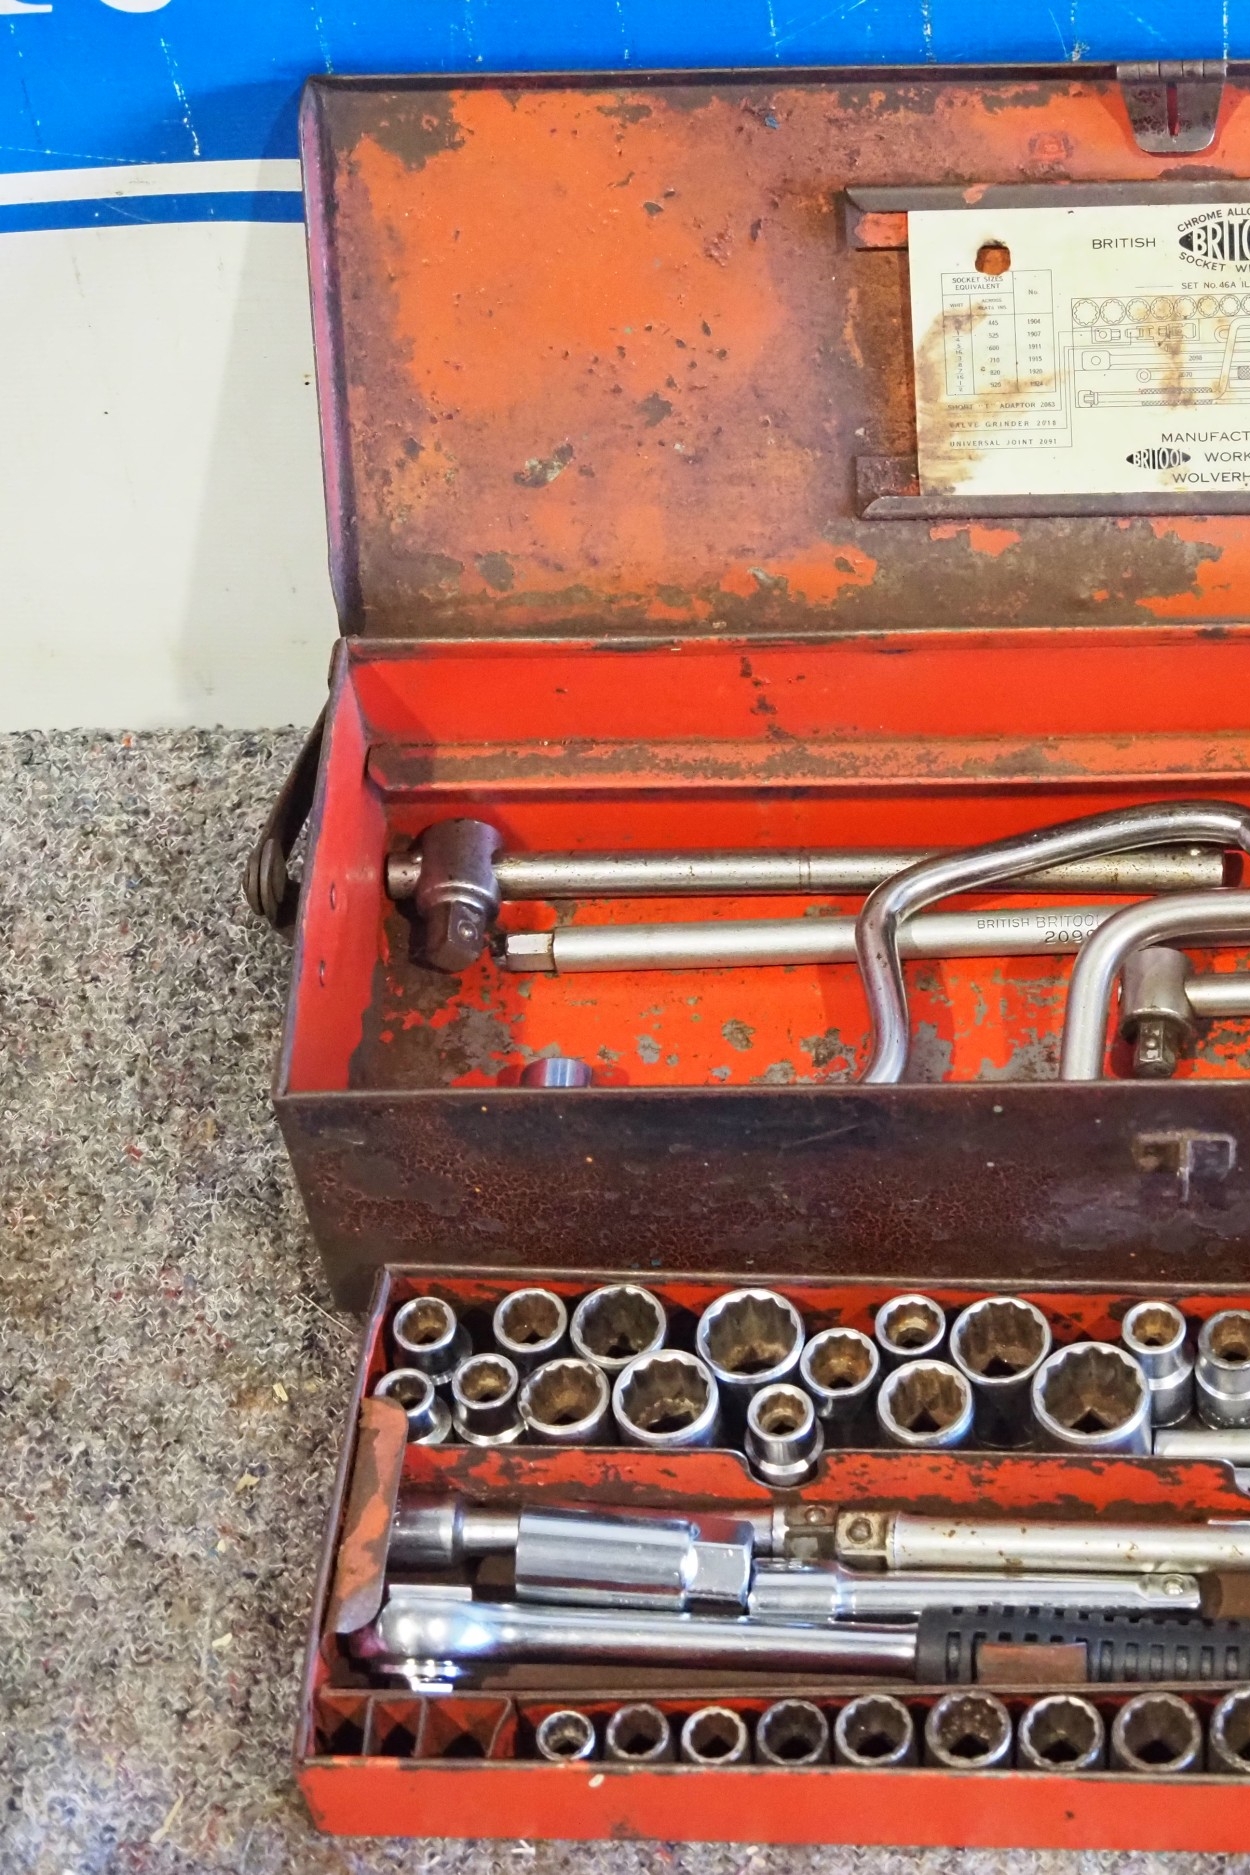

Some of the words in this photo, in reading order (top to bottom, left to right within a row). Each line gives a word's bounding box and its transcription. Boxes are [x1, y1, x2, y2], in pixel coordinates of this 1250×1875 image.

[1177, 209, 1223, 233] CHROME
[1092, 237, 1156, 250] BRITISH
[1178, 251, 1227, 272] SOCKET
[952, 276, 980, 284] SOCKET
[983, 275, 1004, 283] SIZES
[955, 283, 1000, 291] EQUIVALENT
[1181, 281, 1199, 290] SET
[985, 420, 1030, 428] GRINDER
[950, 438, 1001, 447] UNIVERSAL
[1006, 438, 1033, 446] JOINT
[1131, 448, 1187, 469] BRITOOL
[977, 918, 1030, 929] BRITISH
